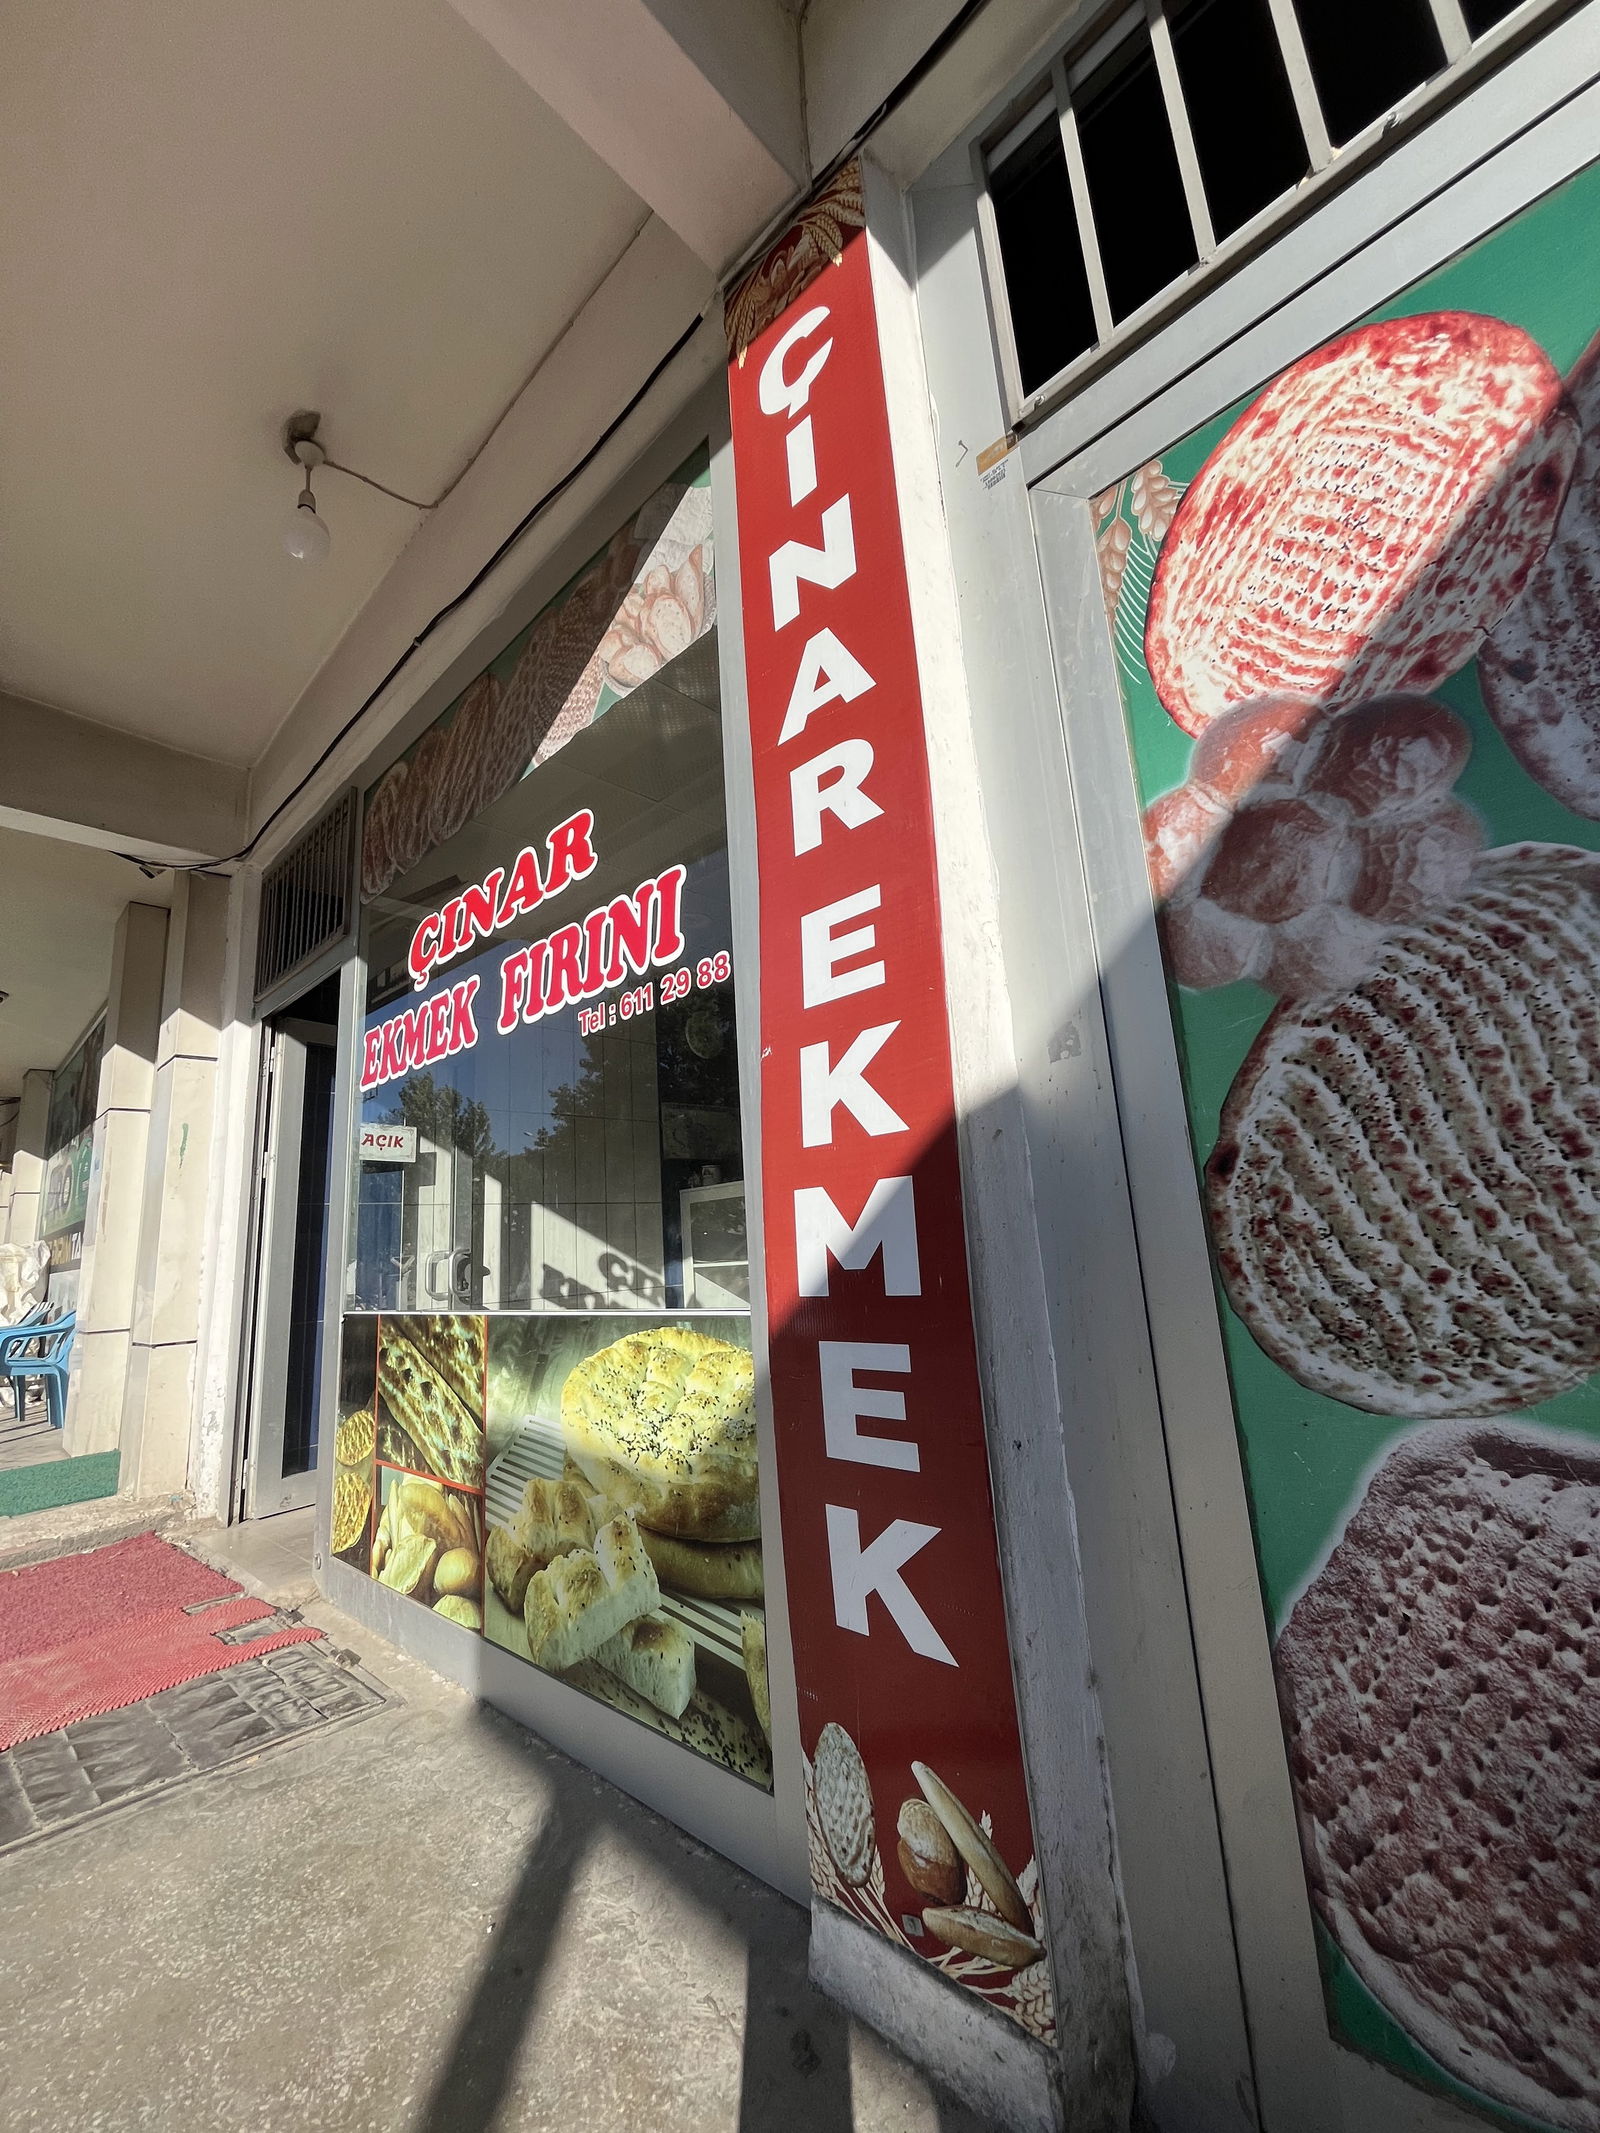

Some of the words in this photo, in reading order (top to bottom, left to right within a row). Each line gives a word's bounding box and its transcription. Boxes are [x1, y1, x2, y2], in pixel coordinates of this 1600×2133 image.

[759, 306, 885, 857] ÇINAR
[359, 974, 481, 1092] EKMEK
[497, 864, 687, 1034] FIRINI
[407, 808, 598, 991] ÇINAR
[619, 982, 654, 1020] 611
[660, 967, 691, 1005] 29
[697, 950, 731, 989] 88
[361, 1133, 404, 1151] AÇIK
[793, 884, 960, 1668] EKMEK
